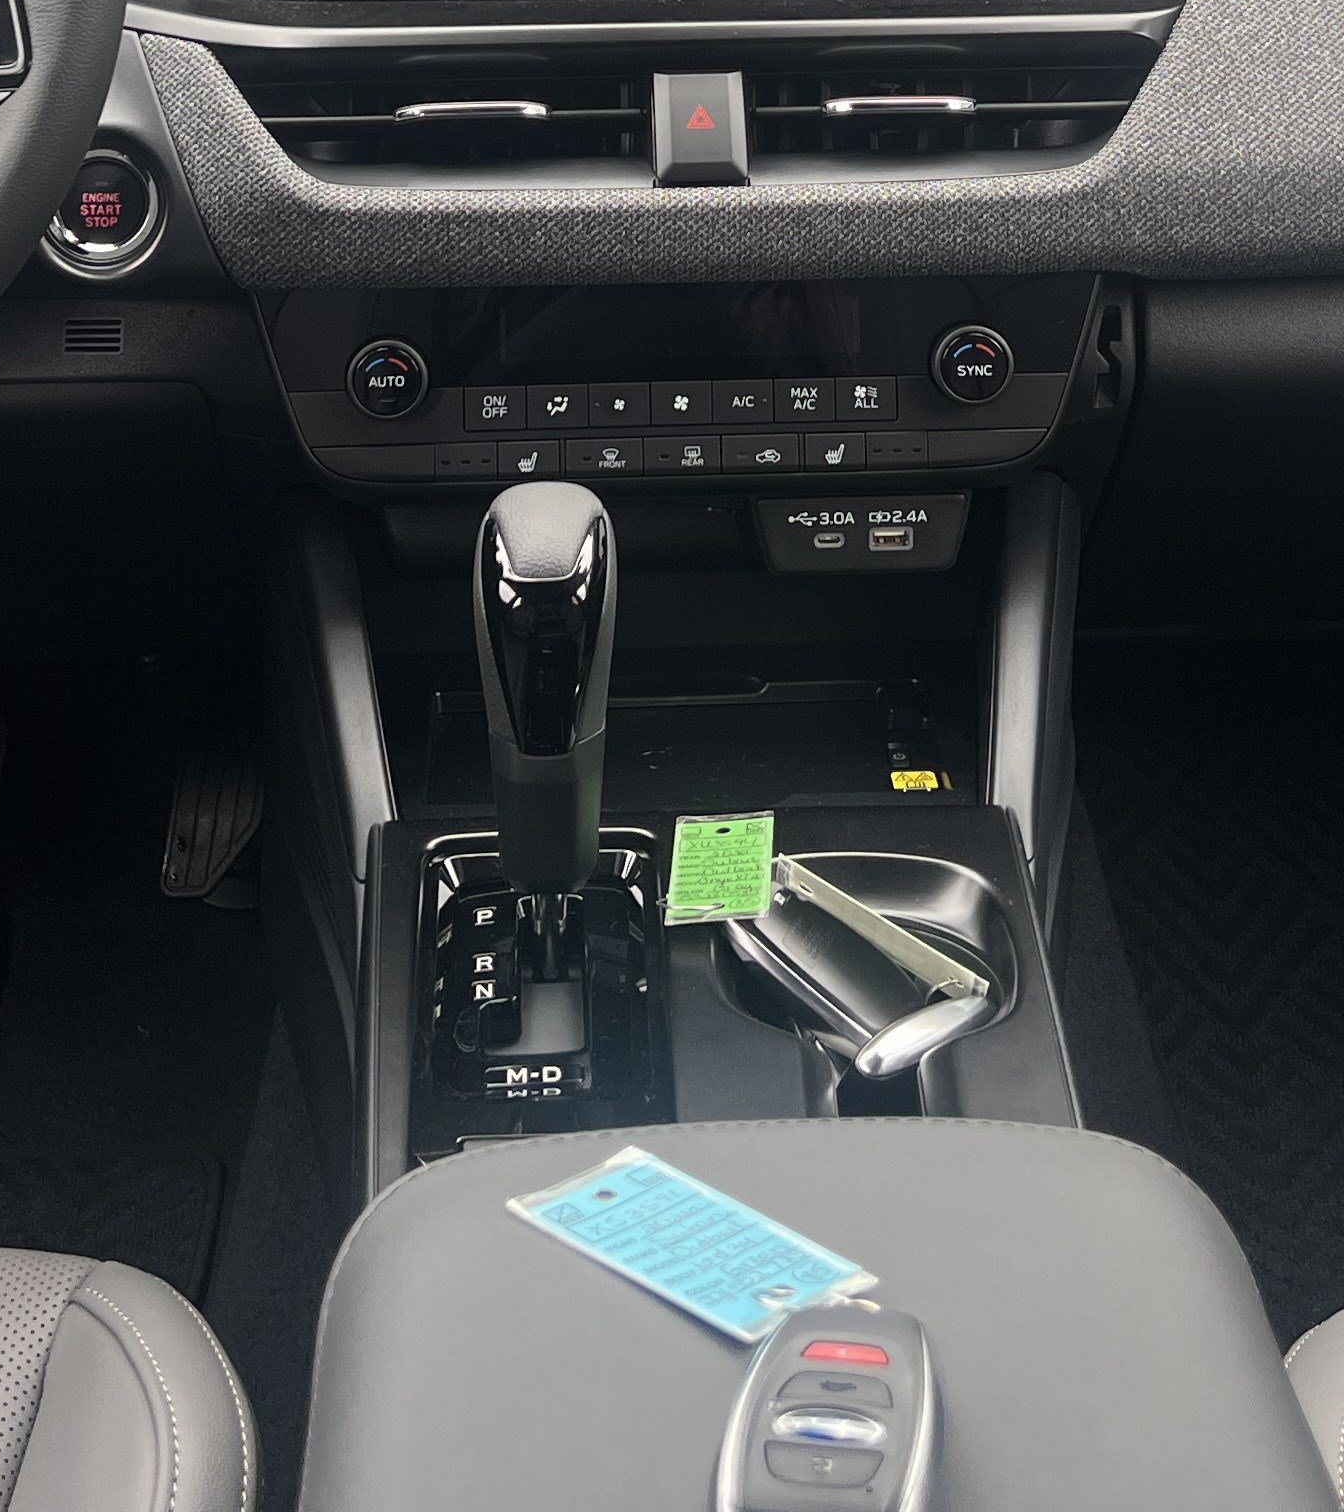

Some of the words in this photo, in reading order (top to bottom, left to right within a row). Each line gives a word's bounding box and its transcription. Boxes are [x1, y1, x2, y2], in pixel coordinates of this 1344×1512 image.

[82, 192, 121, 203] ENGINE
[79, 204, 124, 216] START
[85, 216, 118, 228] STOP
[956, 364, 994, 377] SYNC
[368, 375, 406, 389] AUTO
[790, 387, 818, 399] MAX
[483, 394, 507, 407] ON/
[731, 395, 755, 408] A/C
[793, 398, 816, 411] A/C
[854, 397, 879, 410] ALL
[482, 406, 508, 419] OFF
[681, 457, 704, 467] REAR
[819, 511, 855, 525] 3.0A
[892, 509, 928, 524] 2.4A
[476, 909, 494, 925] P
[476, 955, 494, 972] R
[475, 982, 494, 999] N
[506, 1065, 562, 1085] M-D
